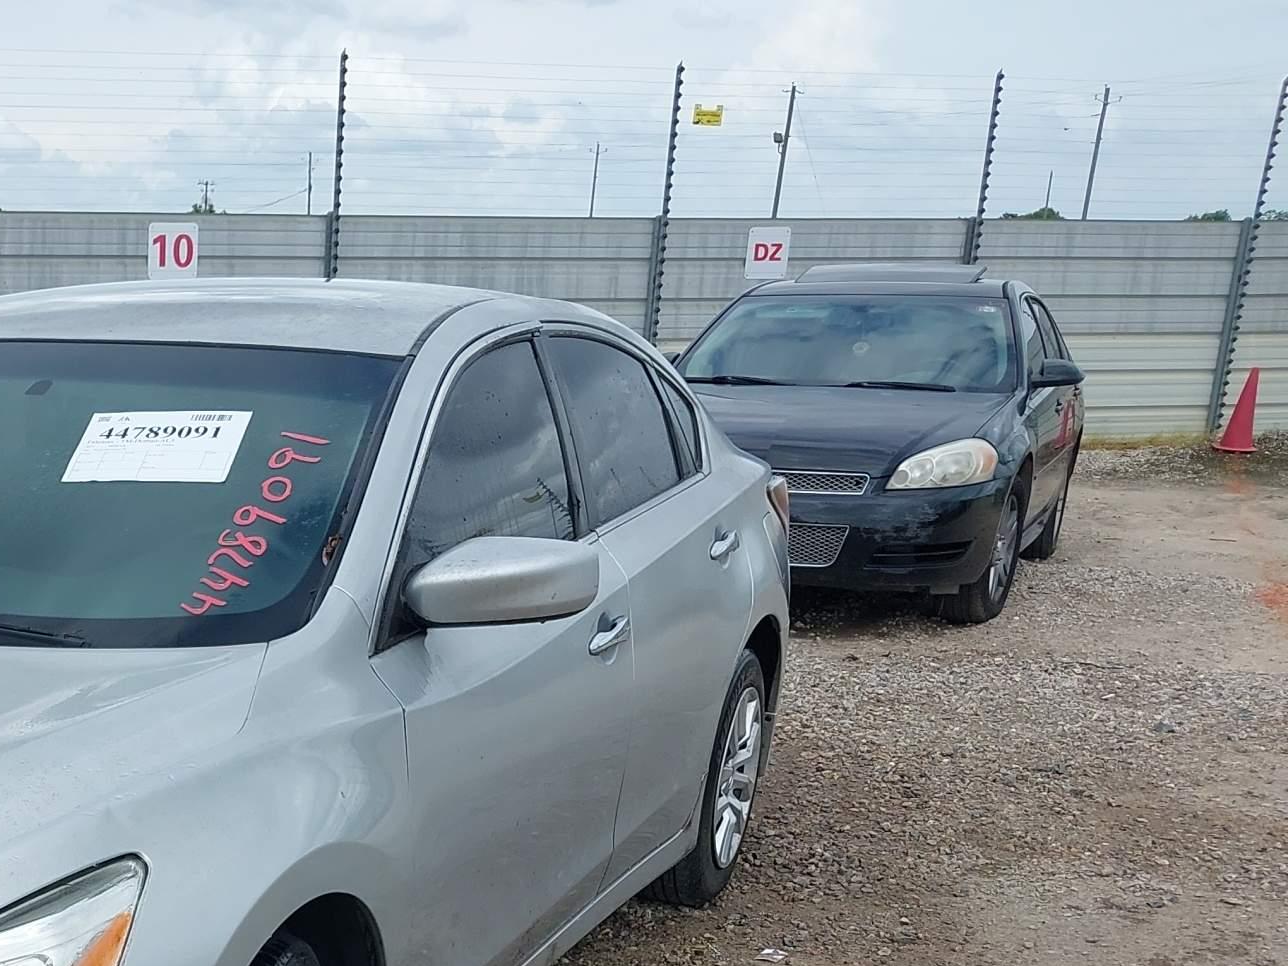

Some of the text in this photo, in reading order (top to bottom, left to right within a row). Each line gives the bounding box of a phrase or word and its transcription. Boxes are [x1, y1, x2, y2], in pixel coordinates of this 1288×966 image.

[152, 233, 194, 268] 10
[753, 243, 784, 262] DZ
[98, 425, 223, 440] 44789091
[179, 430, 332, 616] 44789091
